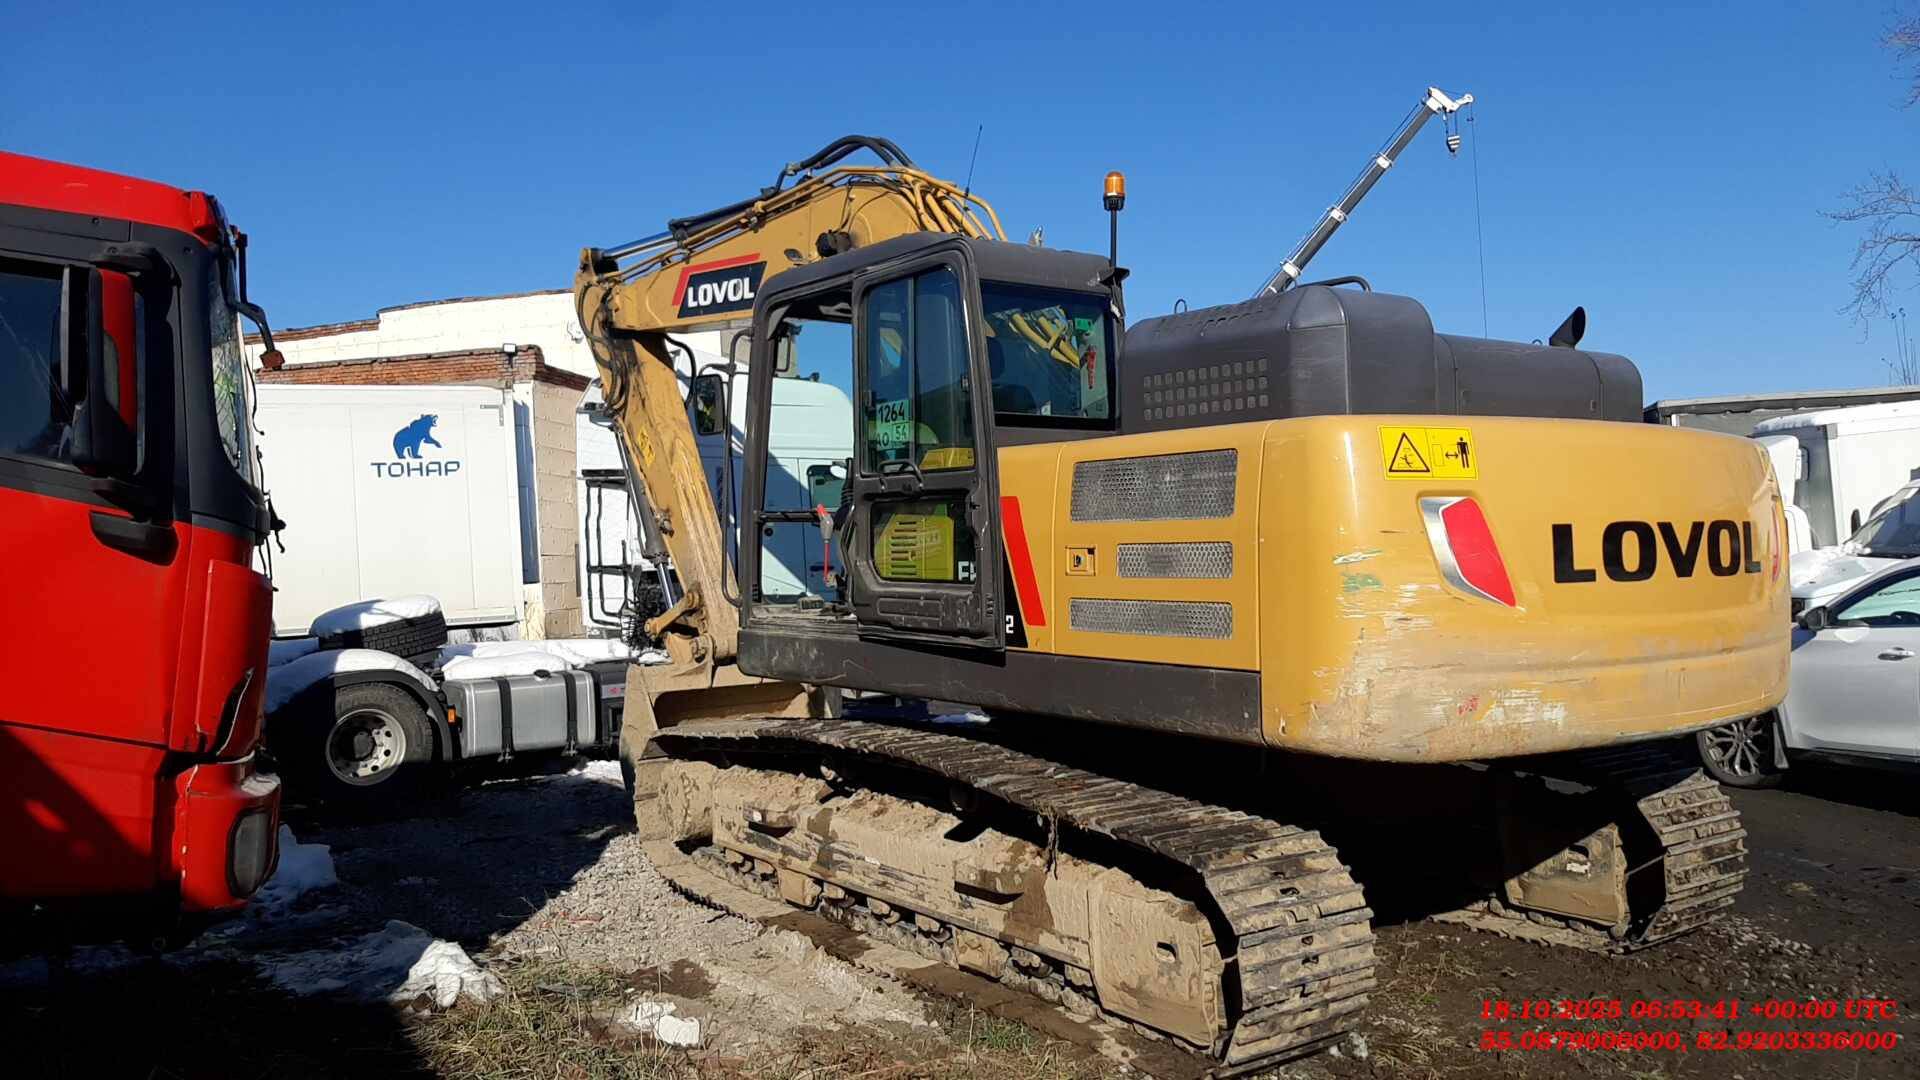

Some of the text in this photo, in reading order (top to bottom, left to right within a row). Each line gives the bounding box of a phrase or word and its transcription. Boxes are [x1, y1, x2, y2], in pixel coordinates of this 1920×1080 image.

[686, 277, 755, 309] LOVOL
[878, 402, 905, 424] 1264
[895, 424, 907, 440] 54
[370, 461, 460, 478] ТОНАР
[1552, 521, 1761, 584] LOVOL
